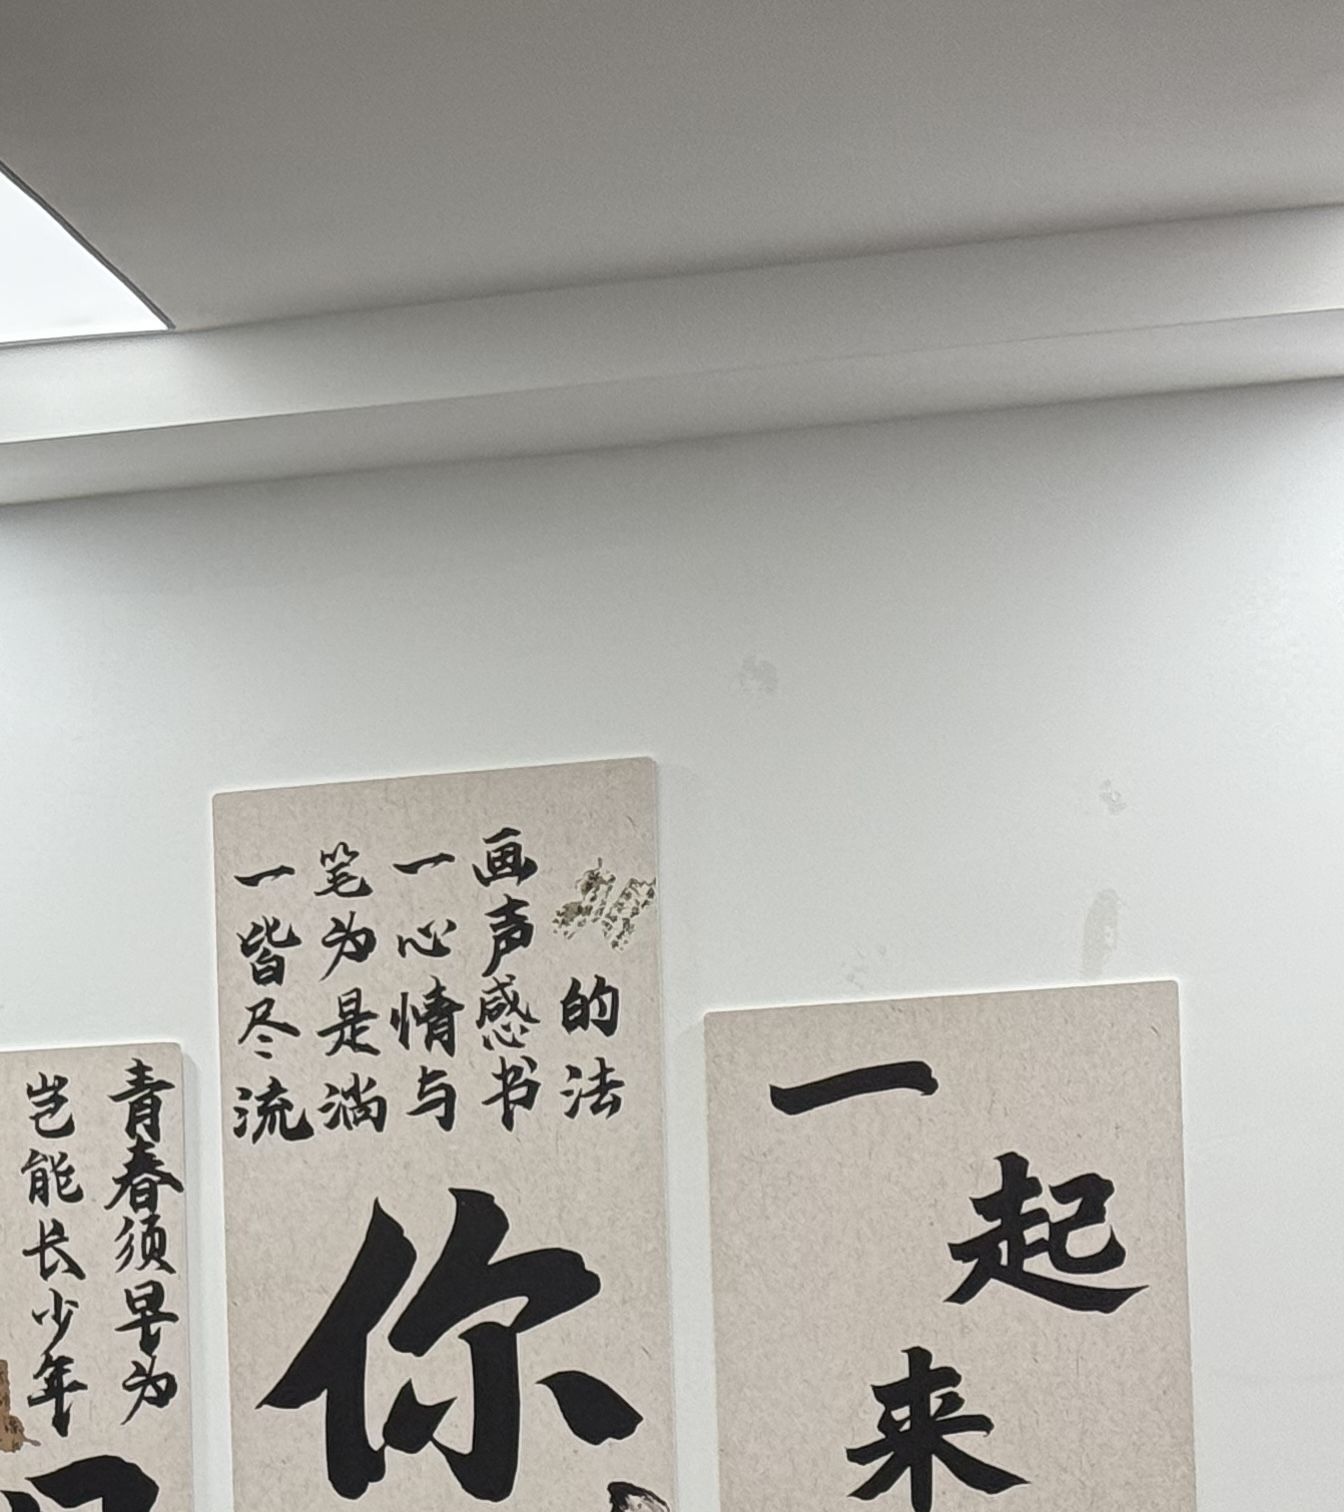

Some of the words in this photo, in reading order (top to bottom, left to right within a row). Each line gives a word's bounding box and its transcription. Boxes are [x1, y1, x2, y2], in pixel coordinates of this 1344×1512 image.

[233, 828, 538, 898] 一笔一画
[236, 893, 535, 987] 皆为心声
[237, 973, 620, 1060] 尽是情感的
[233, 1055, 626, 1145] 流淌与书法
[21, 1072, 88, 1438] 岂能长少年
[104, 1058, 184, 1425] 青春须早为
[255, 1187, 643, 1502] 你
